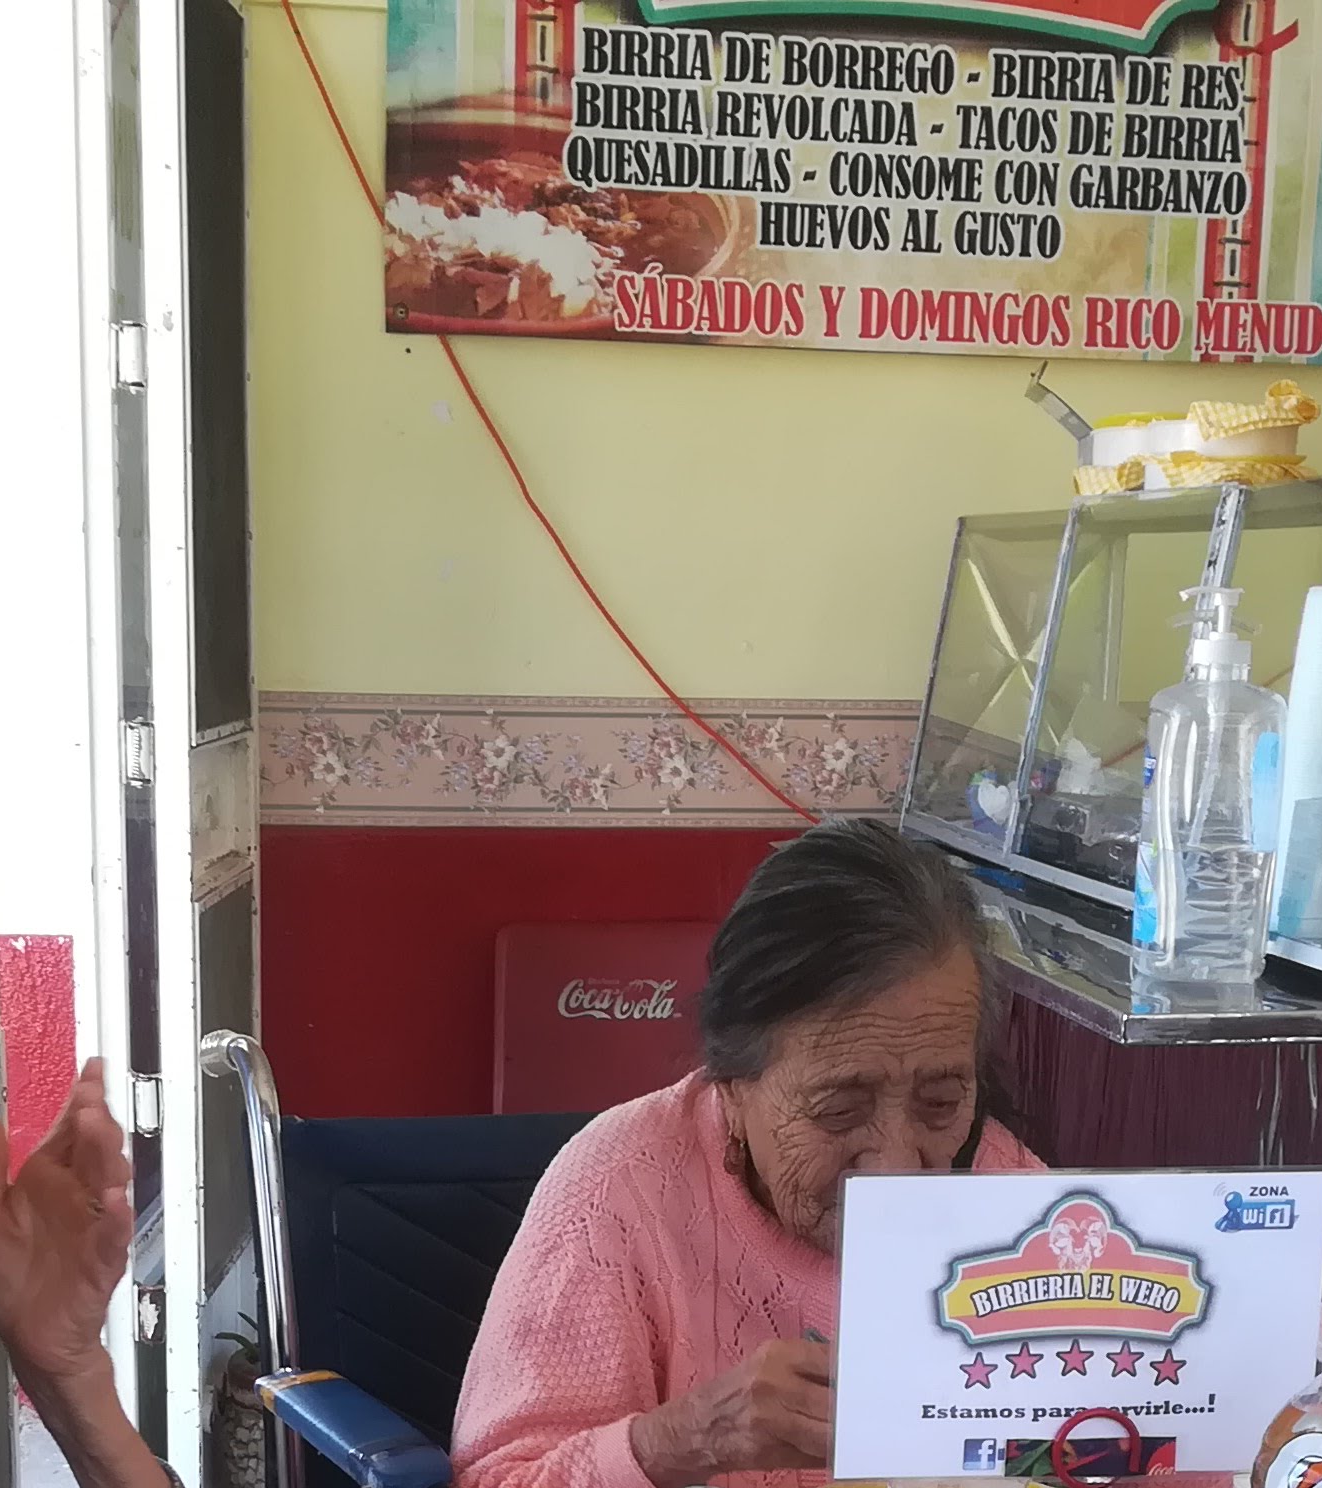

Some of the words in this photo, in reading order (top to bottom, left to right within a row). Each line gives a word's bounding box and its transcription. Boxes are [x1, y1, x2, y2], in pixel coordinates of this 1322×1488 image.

[582, 27, 711, 80] BIRRIA
[723, 36, 771, 84] DE
[782, 39, 955, 95] BORREGO
[991, 52, 1115, 100] BIRRIA
[1126, 60, 1171, 107] DE
[1180, 63, 1239, 112] RES
[575, 82, 702, 135] BIRRIA
[715, 90, 918, 146] REVOLCADA
[956, 104, 1058, 154] TACOS
[1067, 110, 1113, 157] DE
[1122, 112, 1242, 164] BIRRIA
[566, 136, 791, 193] QUESADILLAS
[829, 151, 984, 202] CONSOME
[994, 159, 1060, 207] CON
[1069, 162, 1248, 215] GARBANZO
[759, 200, 890, 252] HUEVOS
[900, 208, 942, 254] AL
[954, 210, 1062, 259] GUSTO
[615, 263, 805, 336] SÁBADOS
[819, 286, 846, 338] Y
[858, 287, 1071, 348] DOMINGOS
[1083, 296, 1182, 351] RICO
[1248, 1186, 1290, 1197] ZONA
[971, 1273, 1084, 1316] BIRRIERIA
[1088, 1273, 1113, 1300] EL
[1120, 1276, 1180, 1314] WERO
[921, 1404, 1026, 1420] Estamos
